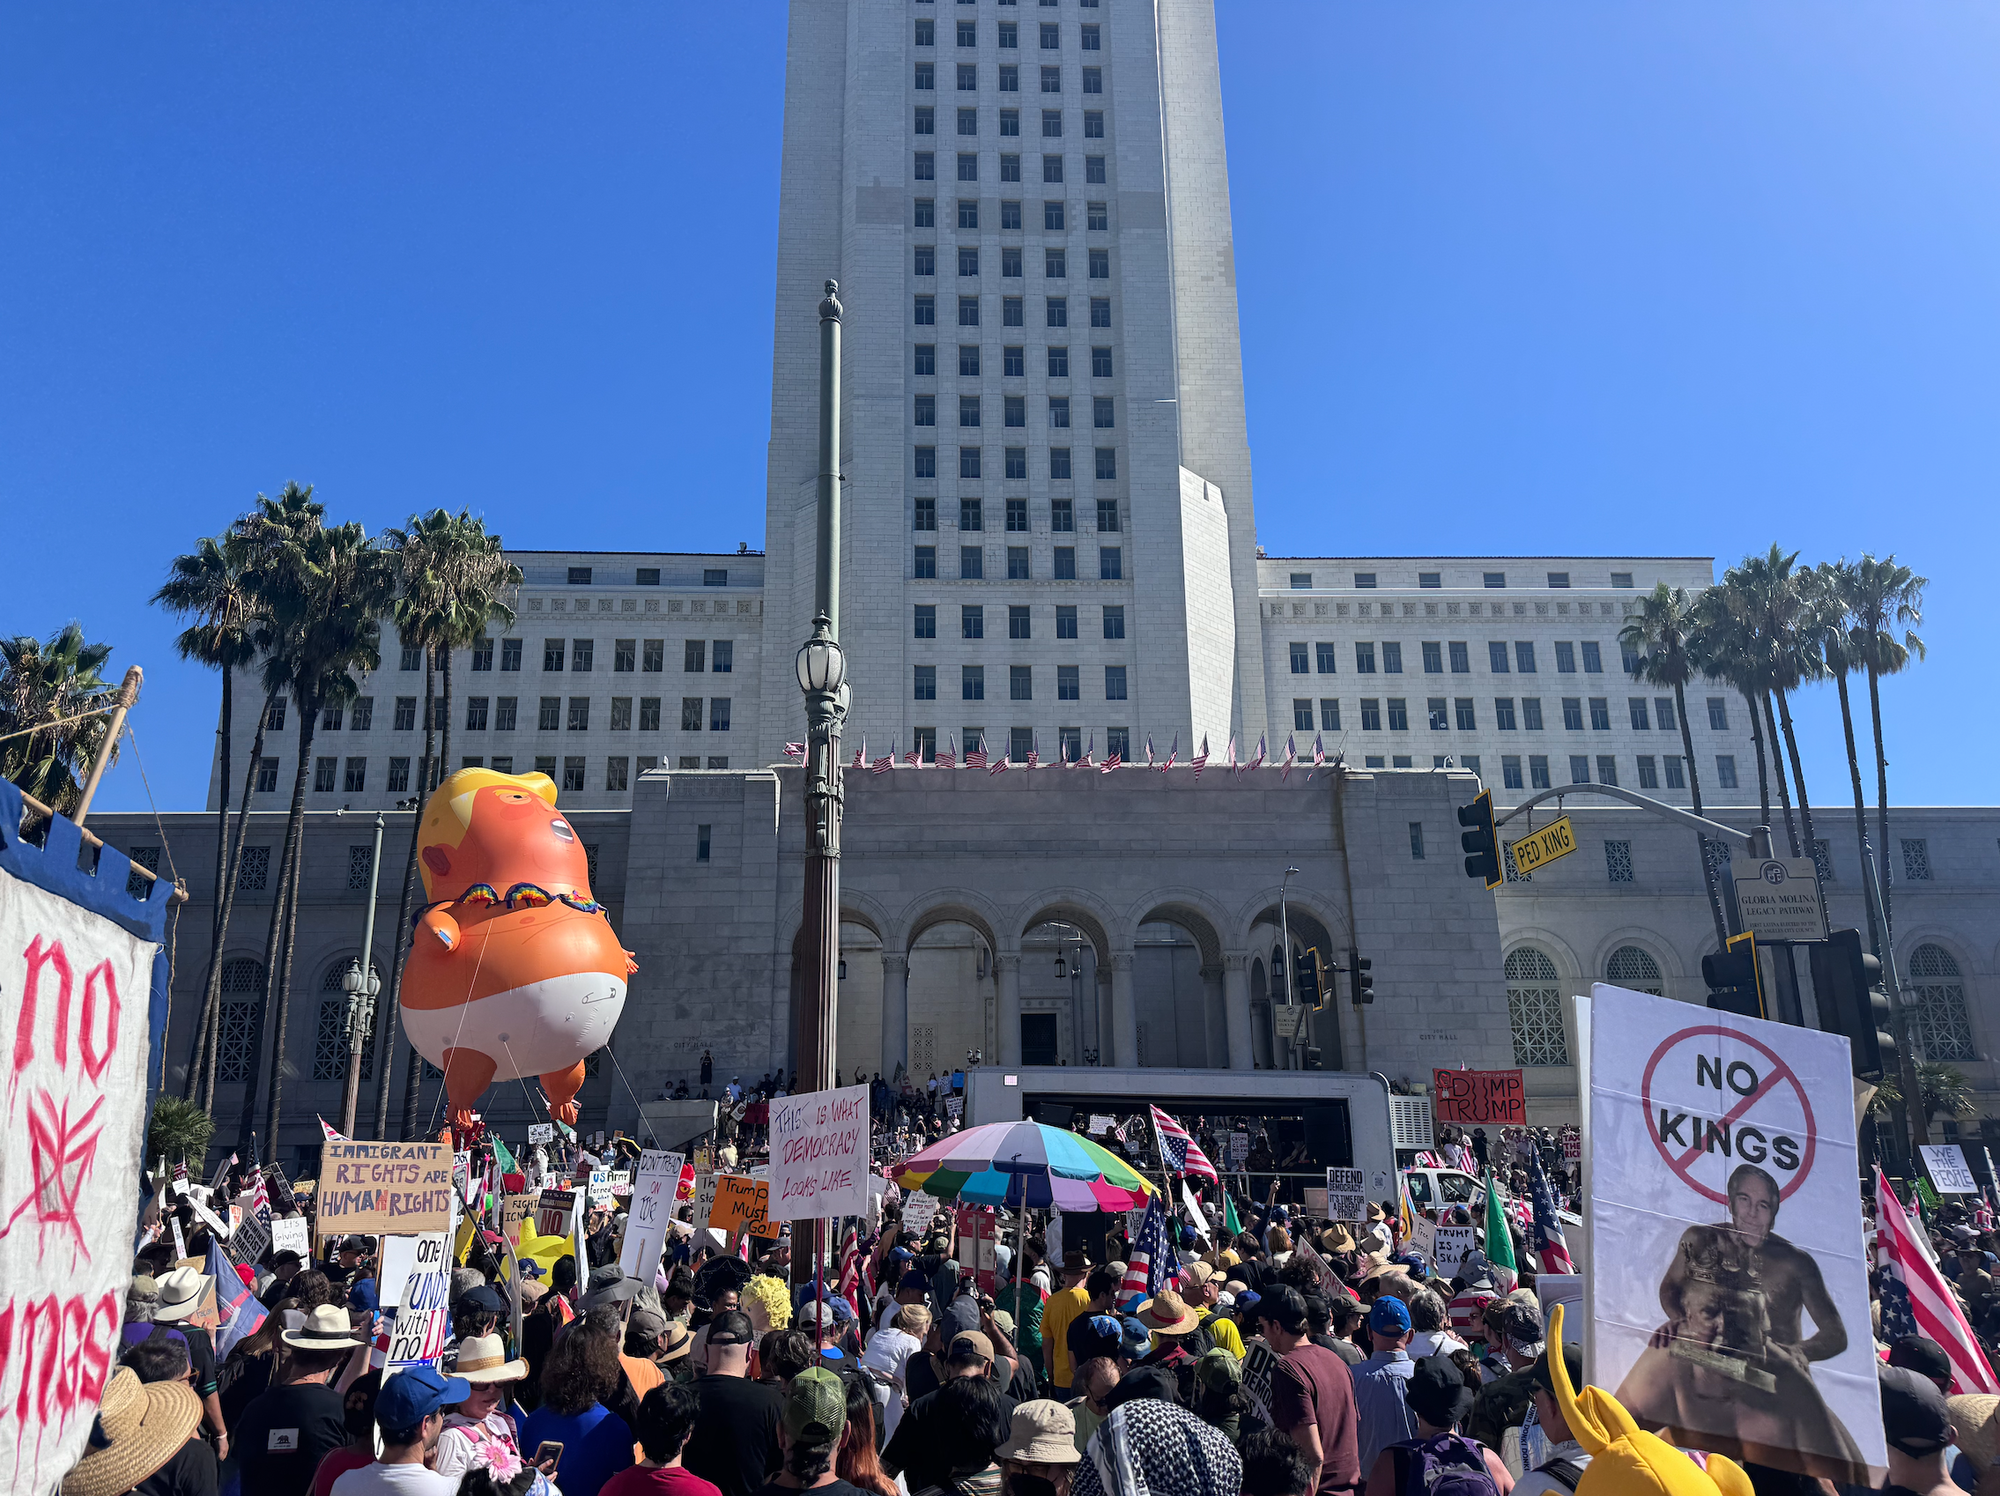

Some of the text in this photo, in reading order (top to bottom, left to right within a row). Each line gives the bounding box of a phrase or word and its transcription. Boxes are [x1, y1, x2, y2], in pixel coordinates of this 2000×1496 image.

[1517, 825, 1570, 868] PED XING
[1741, 894, 1816, 905] GLORIA MOLINA
[1746, 906, 1815, 916] LEGACY PATHWAY
[1696, 1054, 1759, 1097] NO
[1452, 1077, 1521, 1098] DUMP
[774, 1096, 865, 1133] THIS IS WHAT
[1439, 1098, 1522, 1121] TRUMP
[782, 1127, 860, 1165] DEMOCRACY
[1563, 1142, 1581, 1150] THE
[1660, 1108, 1800, 1171] KINGS
[329, 1144, 442, 1160] IMMIGRANT
[1928, 1146, 1955, 1158] WE
[336, 1163, 449, 1184] RIGHTS ARE
[662, 1154, 682, 1174] TREAD
[1932, 1158, 1960, 1169] THE
[593, 1172, 606, 1183] US
[781, 1169, 852, 1201] LOOKS LIKE
[1329, 1169, 1363, 1184] DEFEND
[1931, 1169, 1974, 1188] PEOPLE
[650, 1180, 662, 1195] ON
[723, 1177, 769, 1205] Trump
[321, 1189, 450, 1217] HUMAN RIGHTS
[731, 1201, 769, 1221] Must
[244, 1216, 267, 1247] CRIMINAL
[283, 1220, 300, 1229] It's
[540, 1209, 563, 1235] NO
[748, 1219, 772, 1235] Go!
[274, 1231, 305, 1243] Giving
[1436, 1229, 1470, 1238] TRUMP
[233, 1233, 257, 1265] TRAITOR
[416, 1239, 442, 1264] one
[1438, 1241, 1453, 1251] IS
[1440, 1253, 1462, 1264] SKA
[395, 1311, 429, 1336] with
[390, 1335, 421, 1360] no
[1521, 1447, 1531, 1472] DONKI
